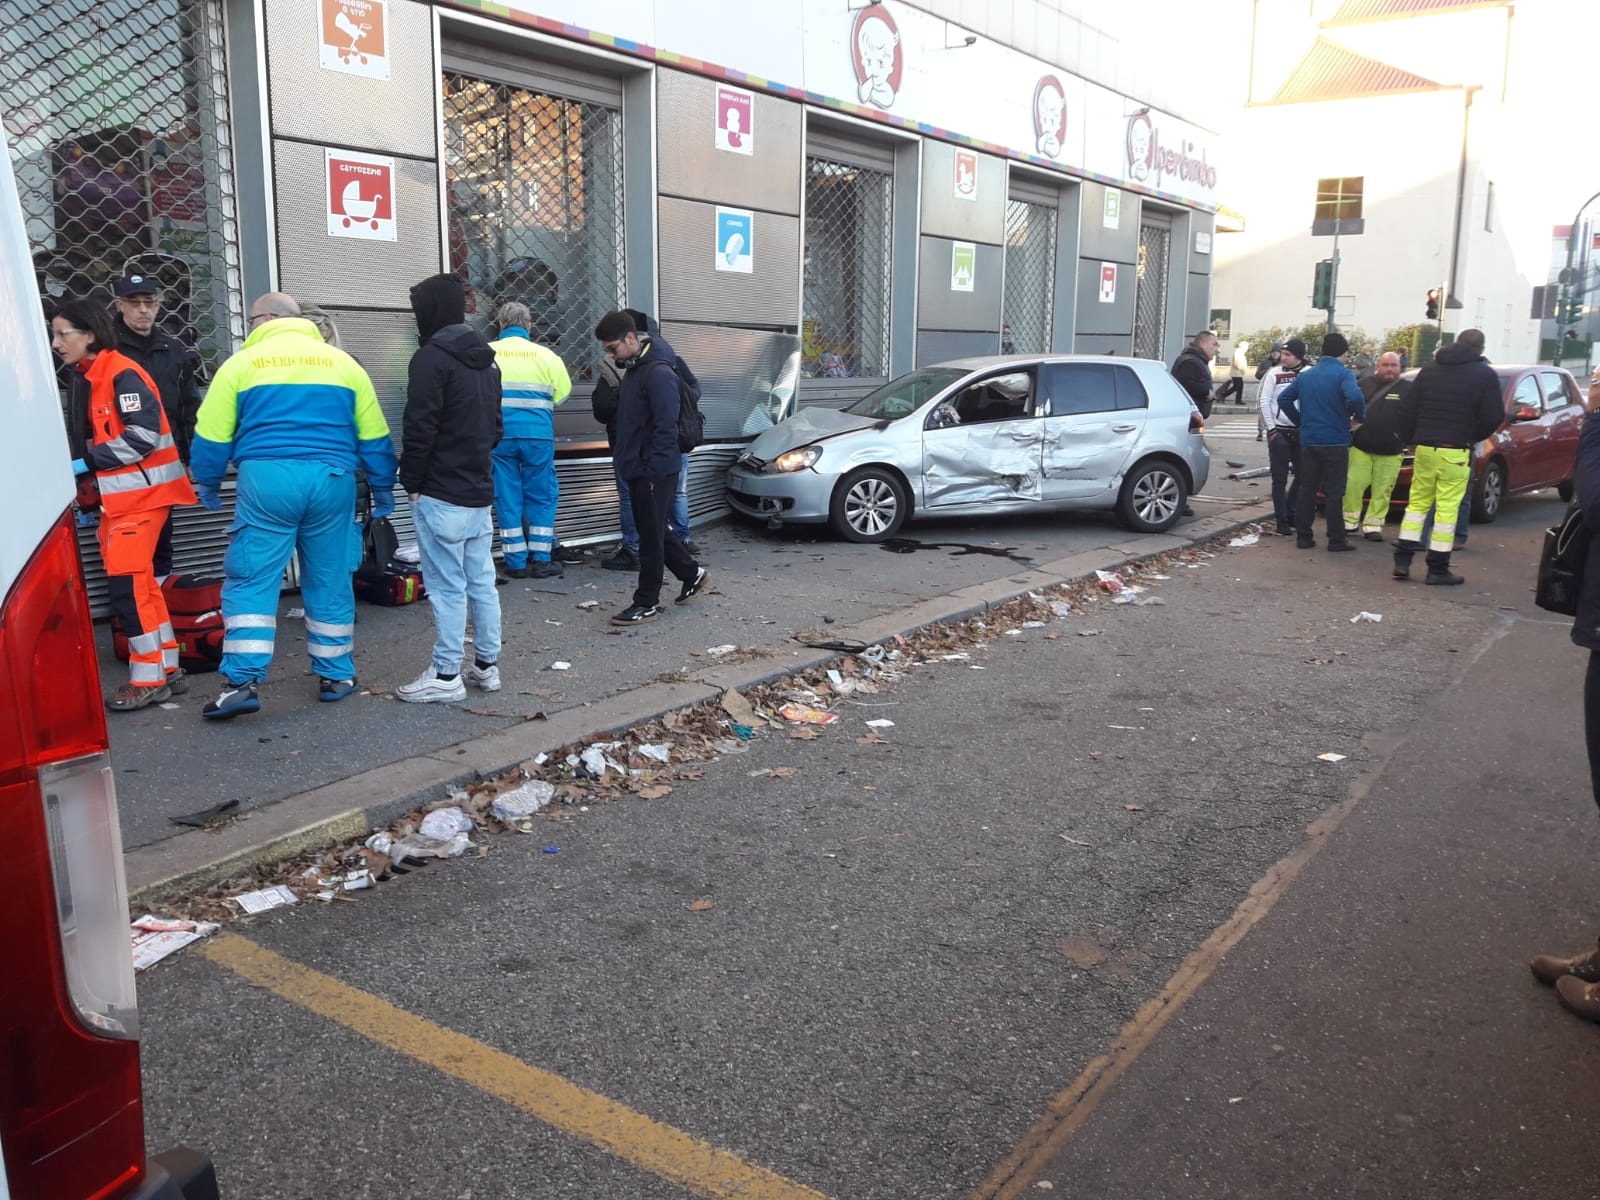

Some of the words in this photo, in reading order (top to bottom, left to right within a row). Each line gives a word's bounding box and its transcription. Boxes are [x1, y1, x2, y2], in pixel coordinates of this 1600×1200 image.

[1153, 127, 1217, 189] Iperbimbo
[339, 163, 382, 176] carrozzine
[251, 356, 336, 369] MISERICORDIE
[123, 394, 138, 402] 118
